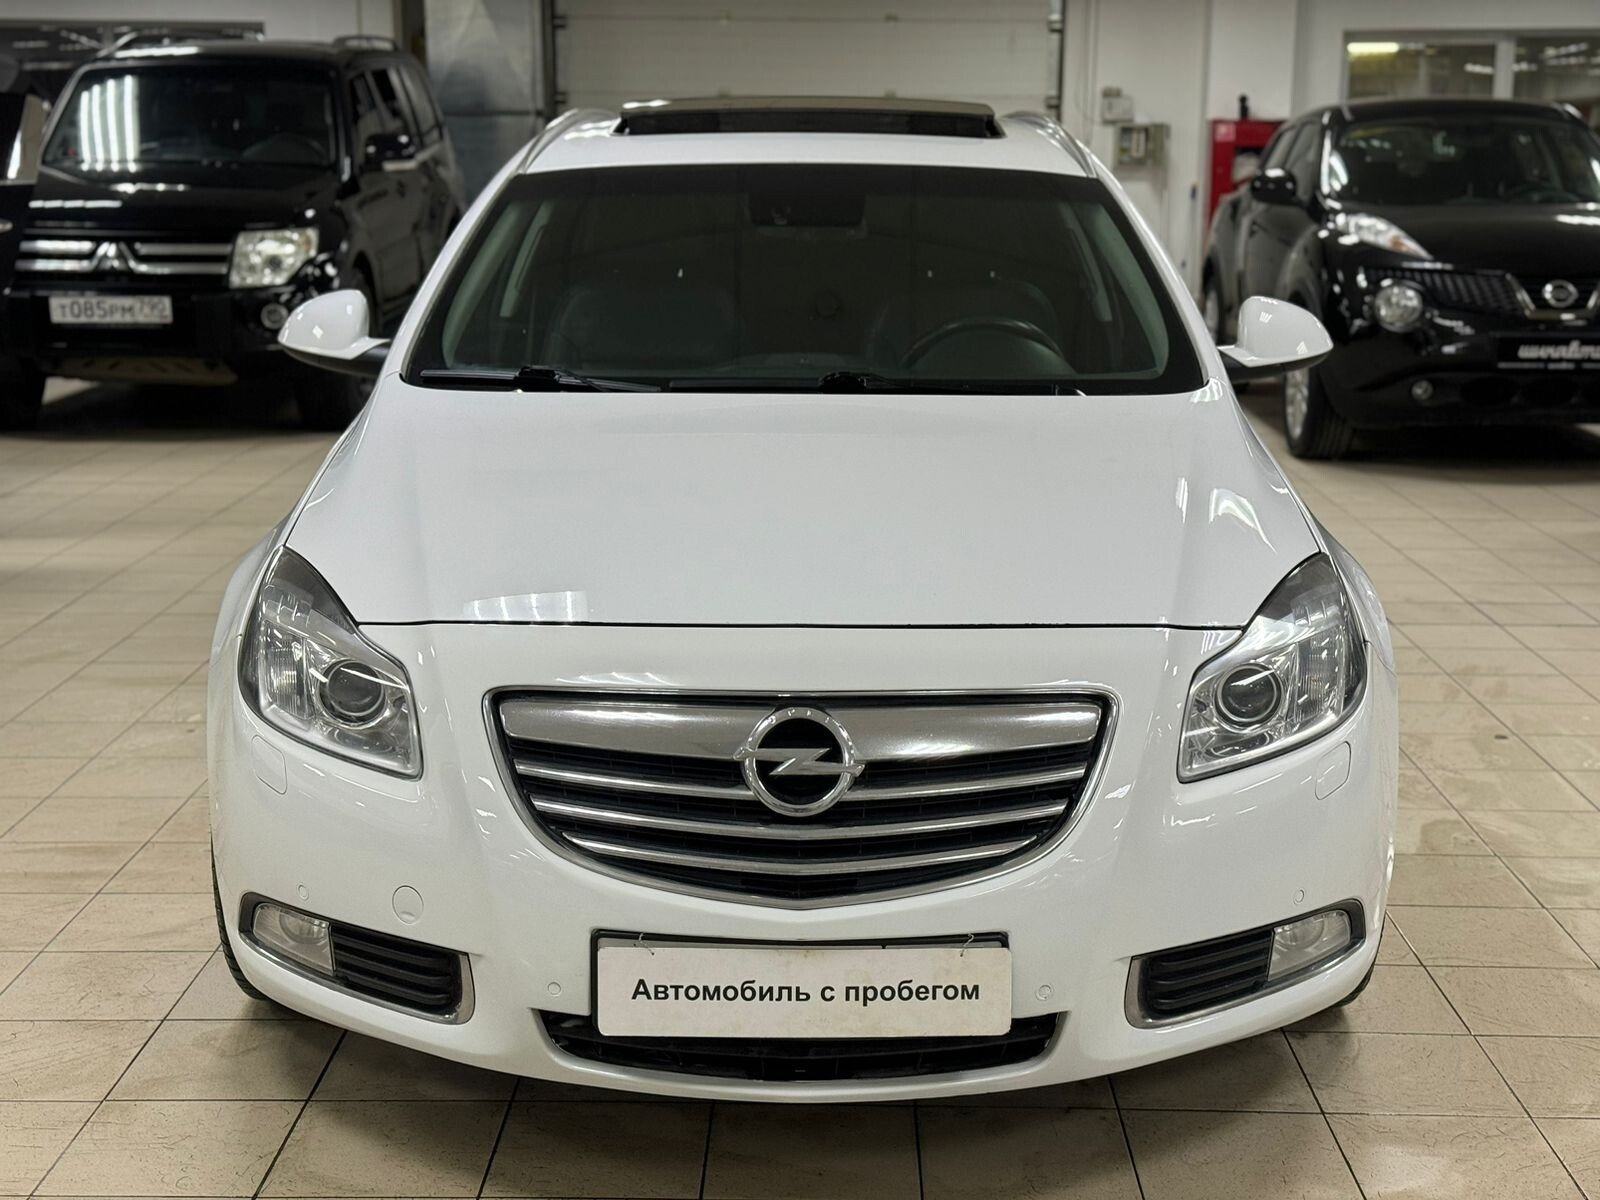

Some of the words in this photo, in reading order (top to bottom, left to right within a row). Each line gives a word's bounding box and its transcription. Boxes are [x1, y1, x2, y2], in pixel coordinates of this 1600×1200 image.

[631, 978, 811, 1002] Автомобиль
[820, 985, 835, 1002] с
[845, 979, 980, 1007] пробегом
